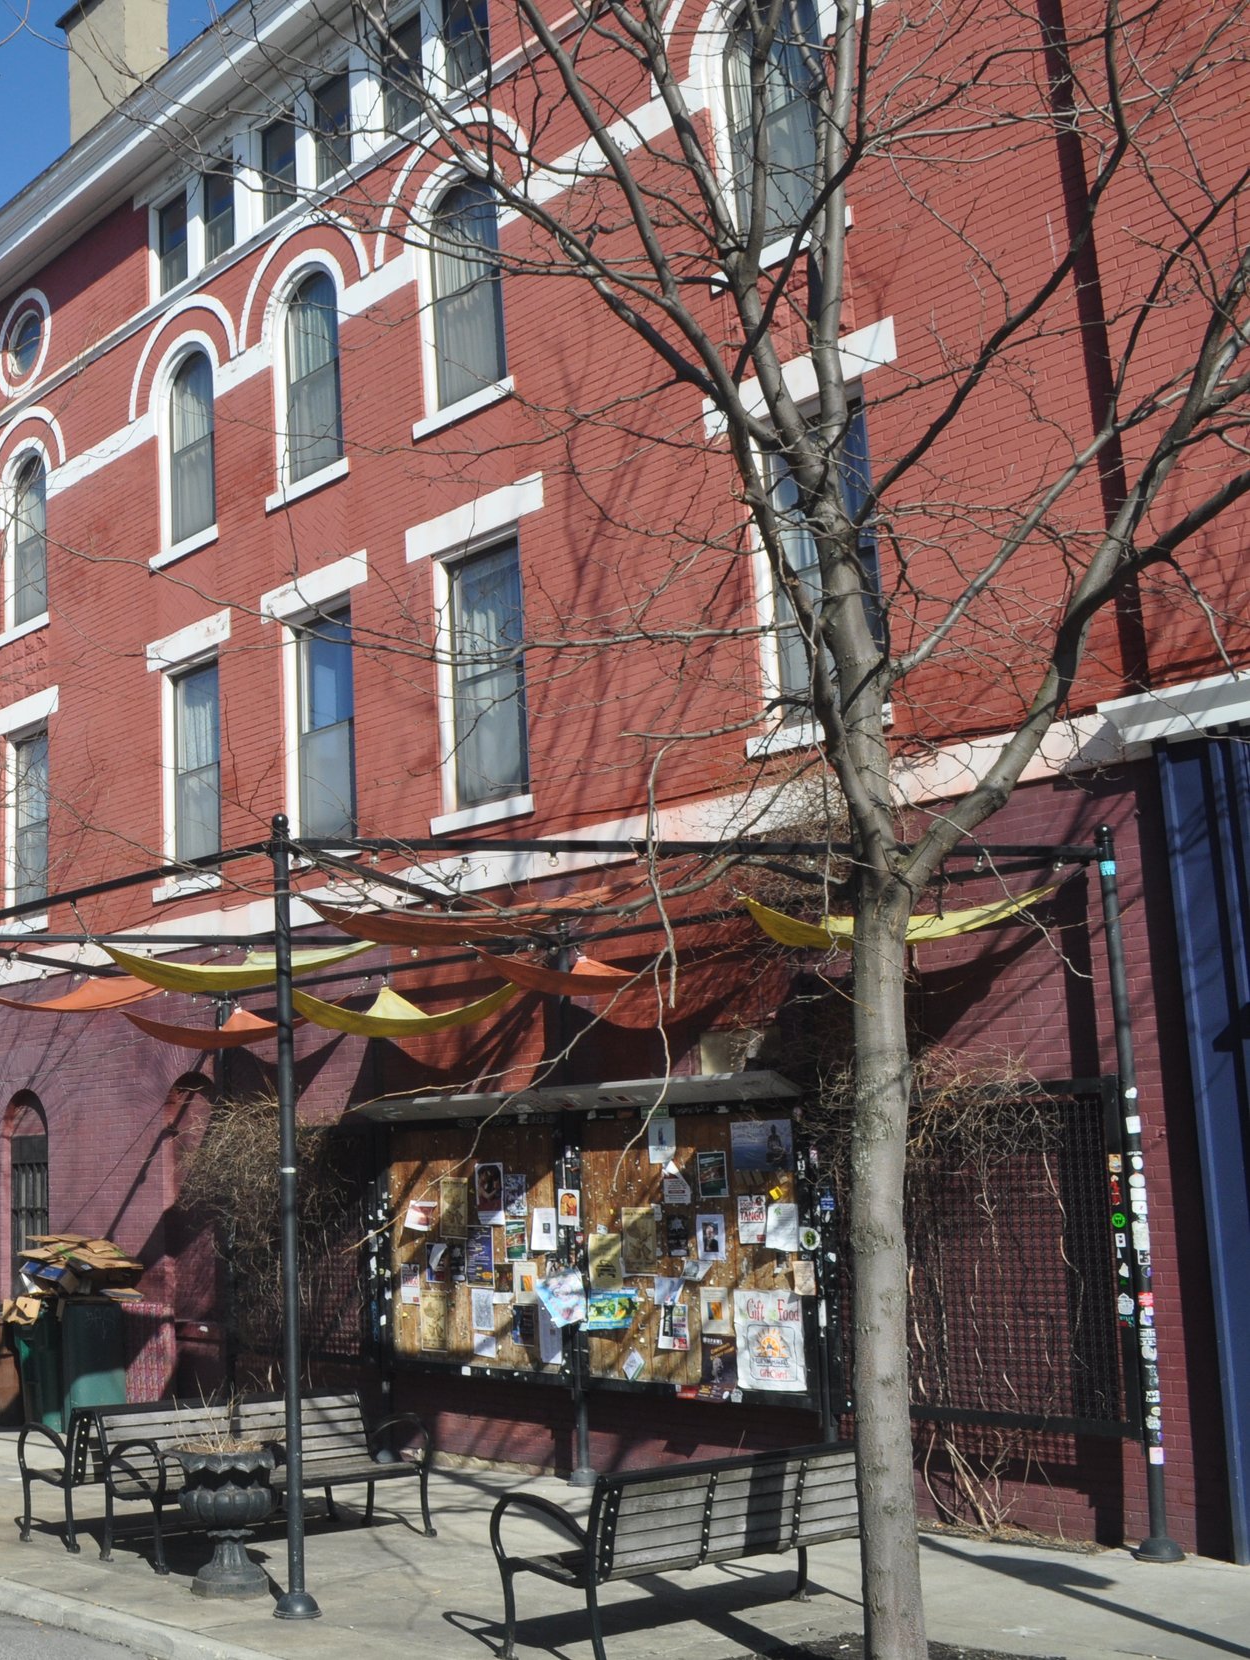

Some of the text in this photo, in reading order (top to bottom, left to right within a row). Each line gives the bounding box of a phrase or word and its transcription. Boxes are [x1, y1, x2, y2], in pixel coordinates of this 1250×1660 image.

[739, 1211, 764, 1222] TANGO
[746, 1298, 800, 1321] Gift Food
